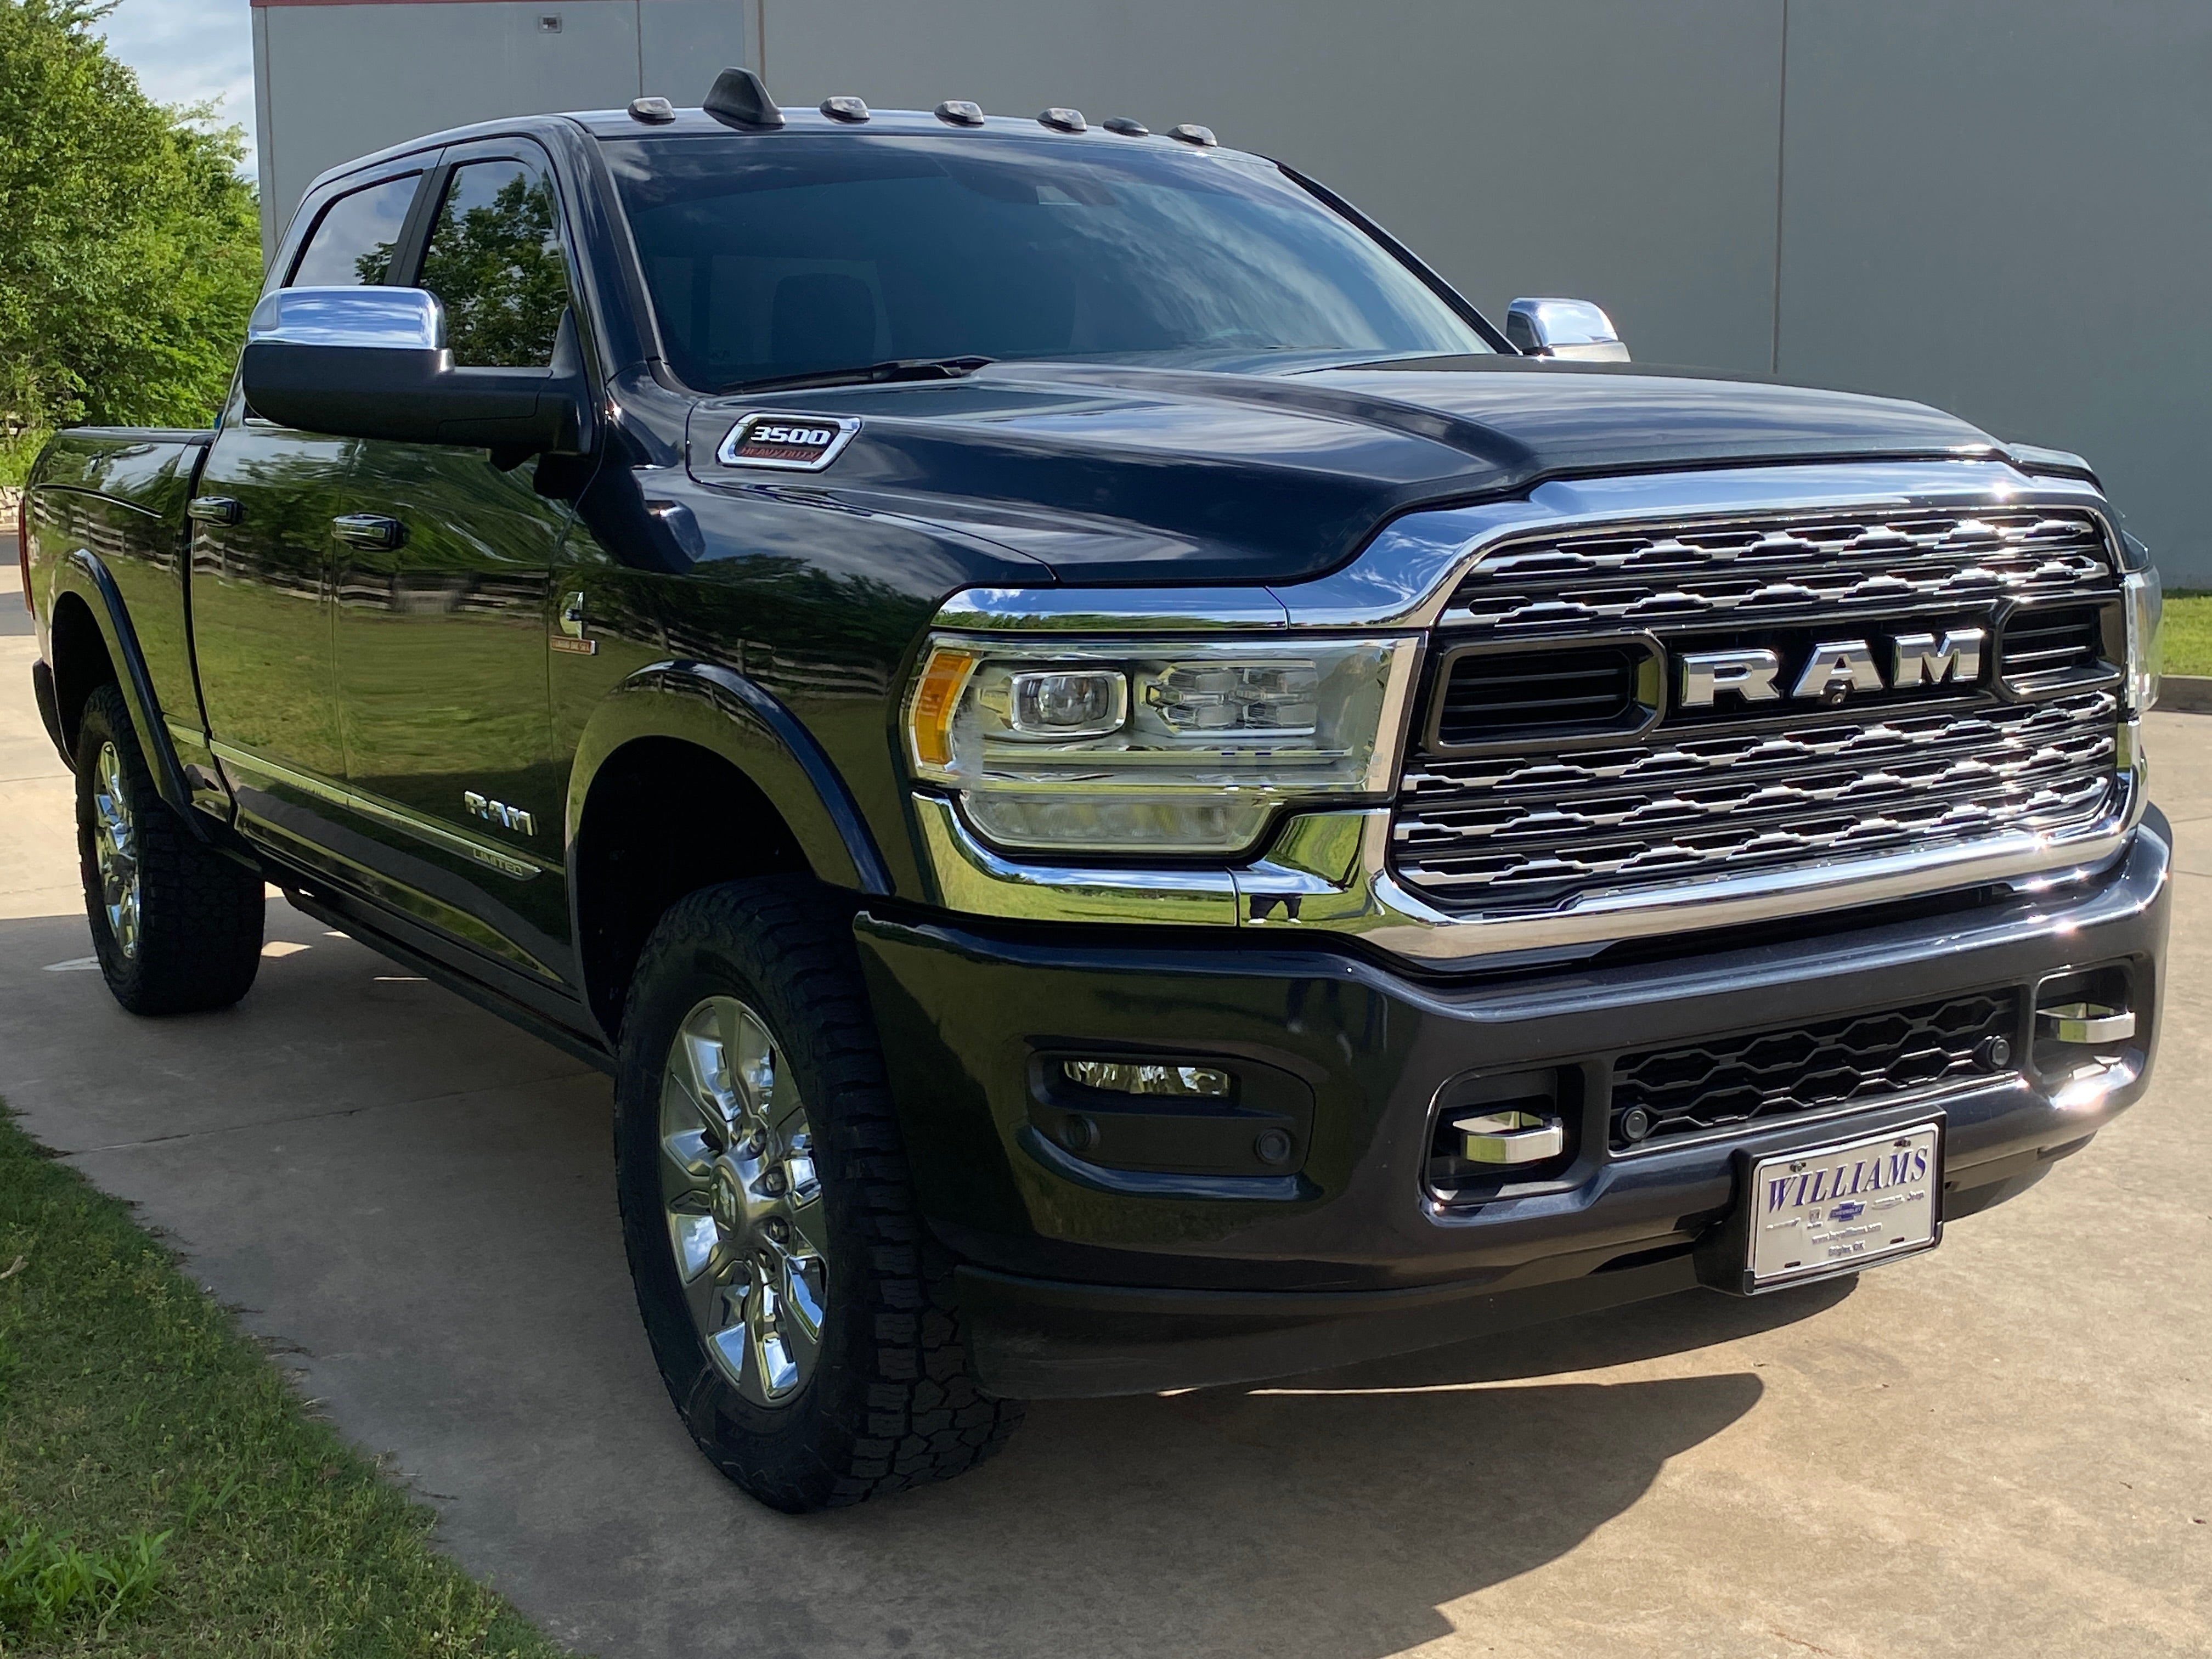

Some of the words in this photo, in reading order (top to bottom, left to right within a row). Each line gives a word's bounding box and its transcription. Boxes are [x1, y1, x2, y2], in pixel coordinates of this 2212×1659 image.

[740, 447, 783, 458] HEAVY
[751, 426, 831, 444] 3500
[1679, 628, 1985, 707] RAM
[464, 791, 534, 836] RAM
[473, 848, 523, 876] LIMITED
[1768, 1145, 1929, 1214] WILLIAMS
